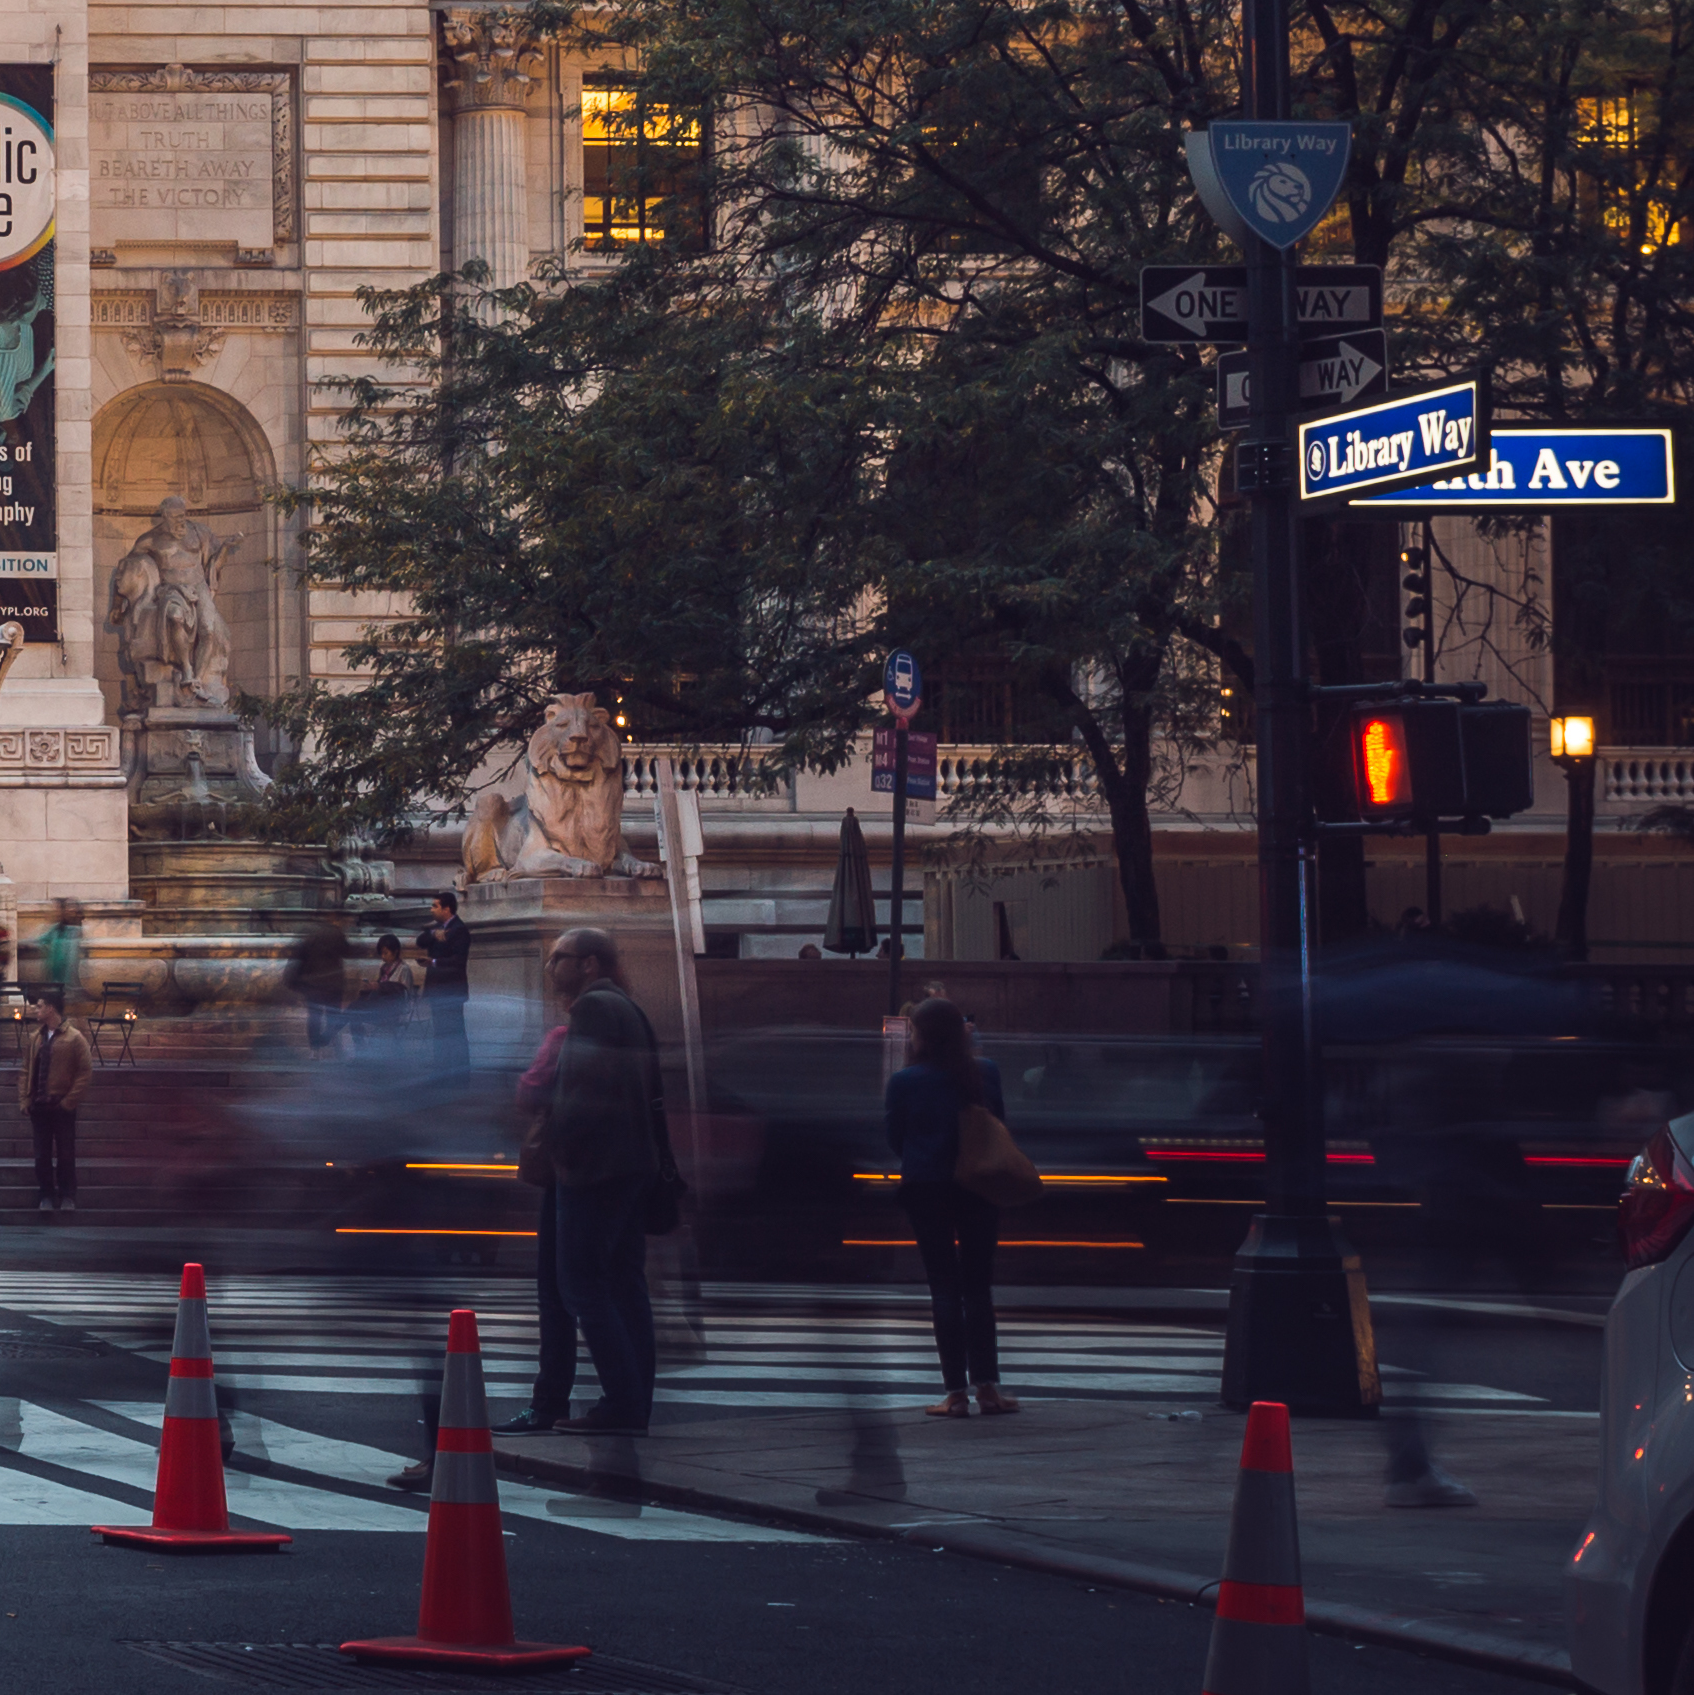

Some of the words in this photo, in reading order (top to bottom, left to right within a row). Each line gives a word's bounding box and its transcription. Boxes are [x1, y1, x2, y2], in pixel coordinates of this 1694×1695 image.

[118, 103, 170, 120] ABOVE
[173, 103, 202, 120] ALL
[205, 103, 267, 120] THINGS
[140, 131, 210, 149] TRUTH
[1224, 133, 1292, 155] Library
[1296, 134, 1338, 155] Way
[99, 160, 189, 178] BEARETH
[198, 160, 255, 178] AWAY
[109, 188, 148, 206] THE
[157, 188, 247, 206] VICTORY
[1174, 289, 1239, 319] ONE
[1317, 357, 1365, 391] WAY
[15, 441, 33, 462] of
[1327, 430, 1414, 478] Library
[1417, 409, 1473, 459] Way
[1528, 448, 1621, 490] Ave
[874, 773, 893, 789] Q32
